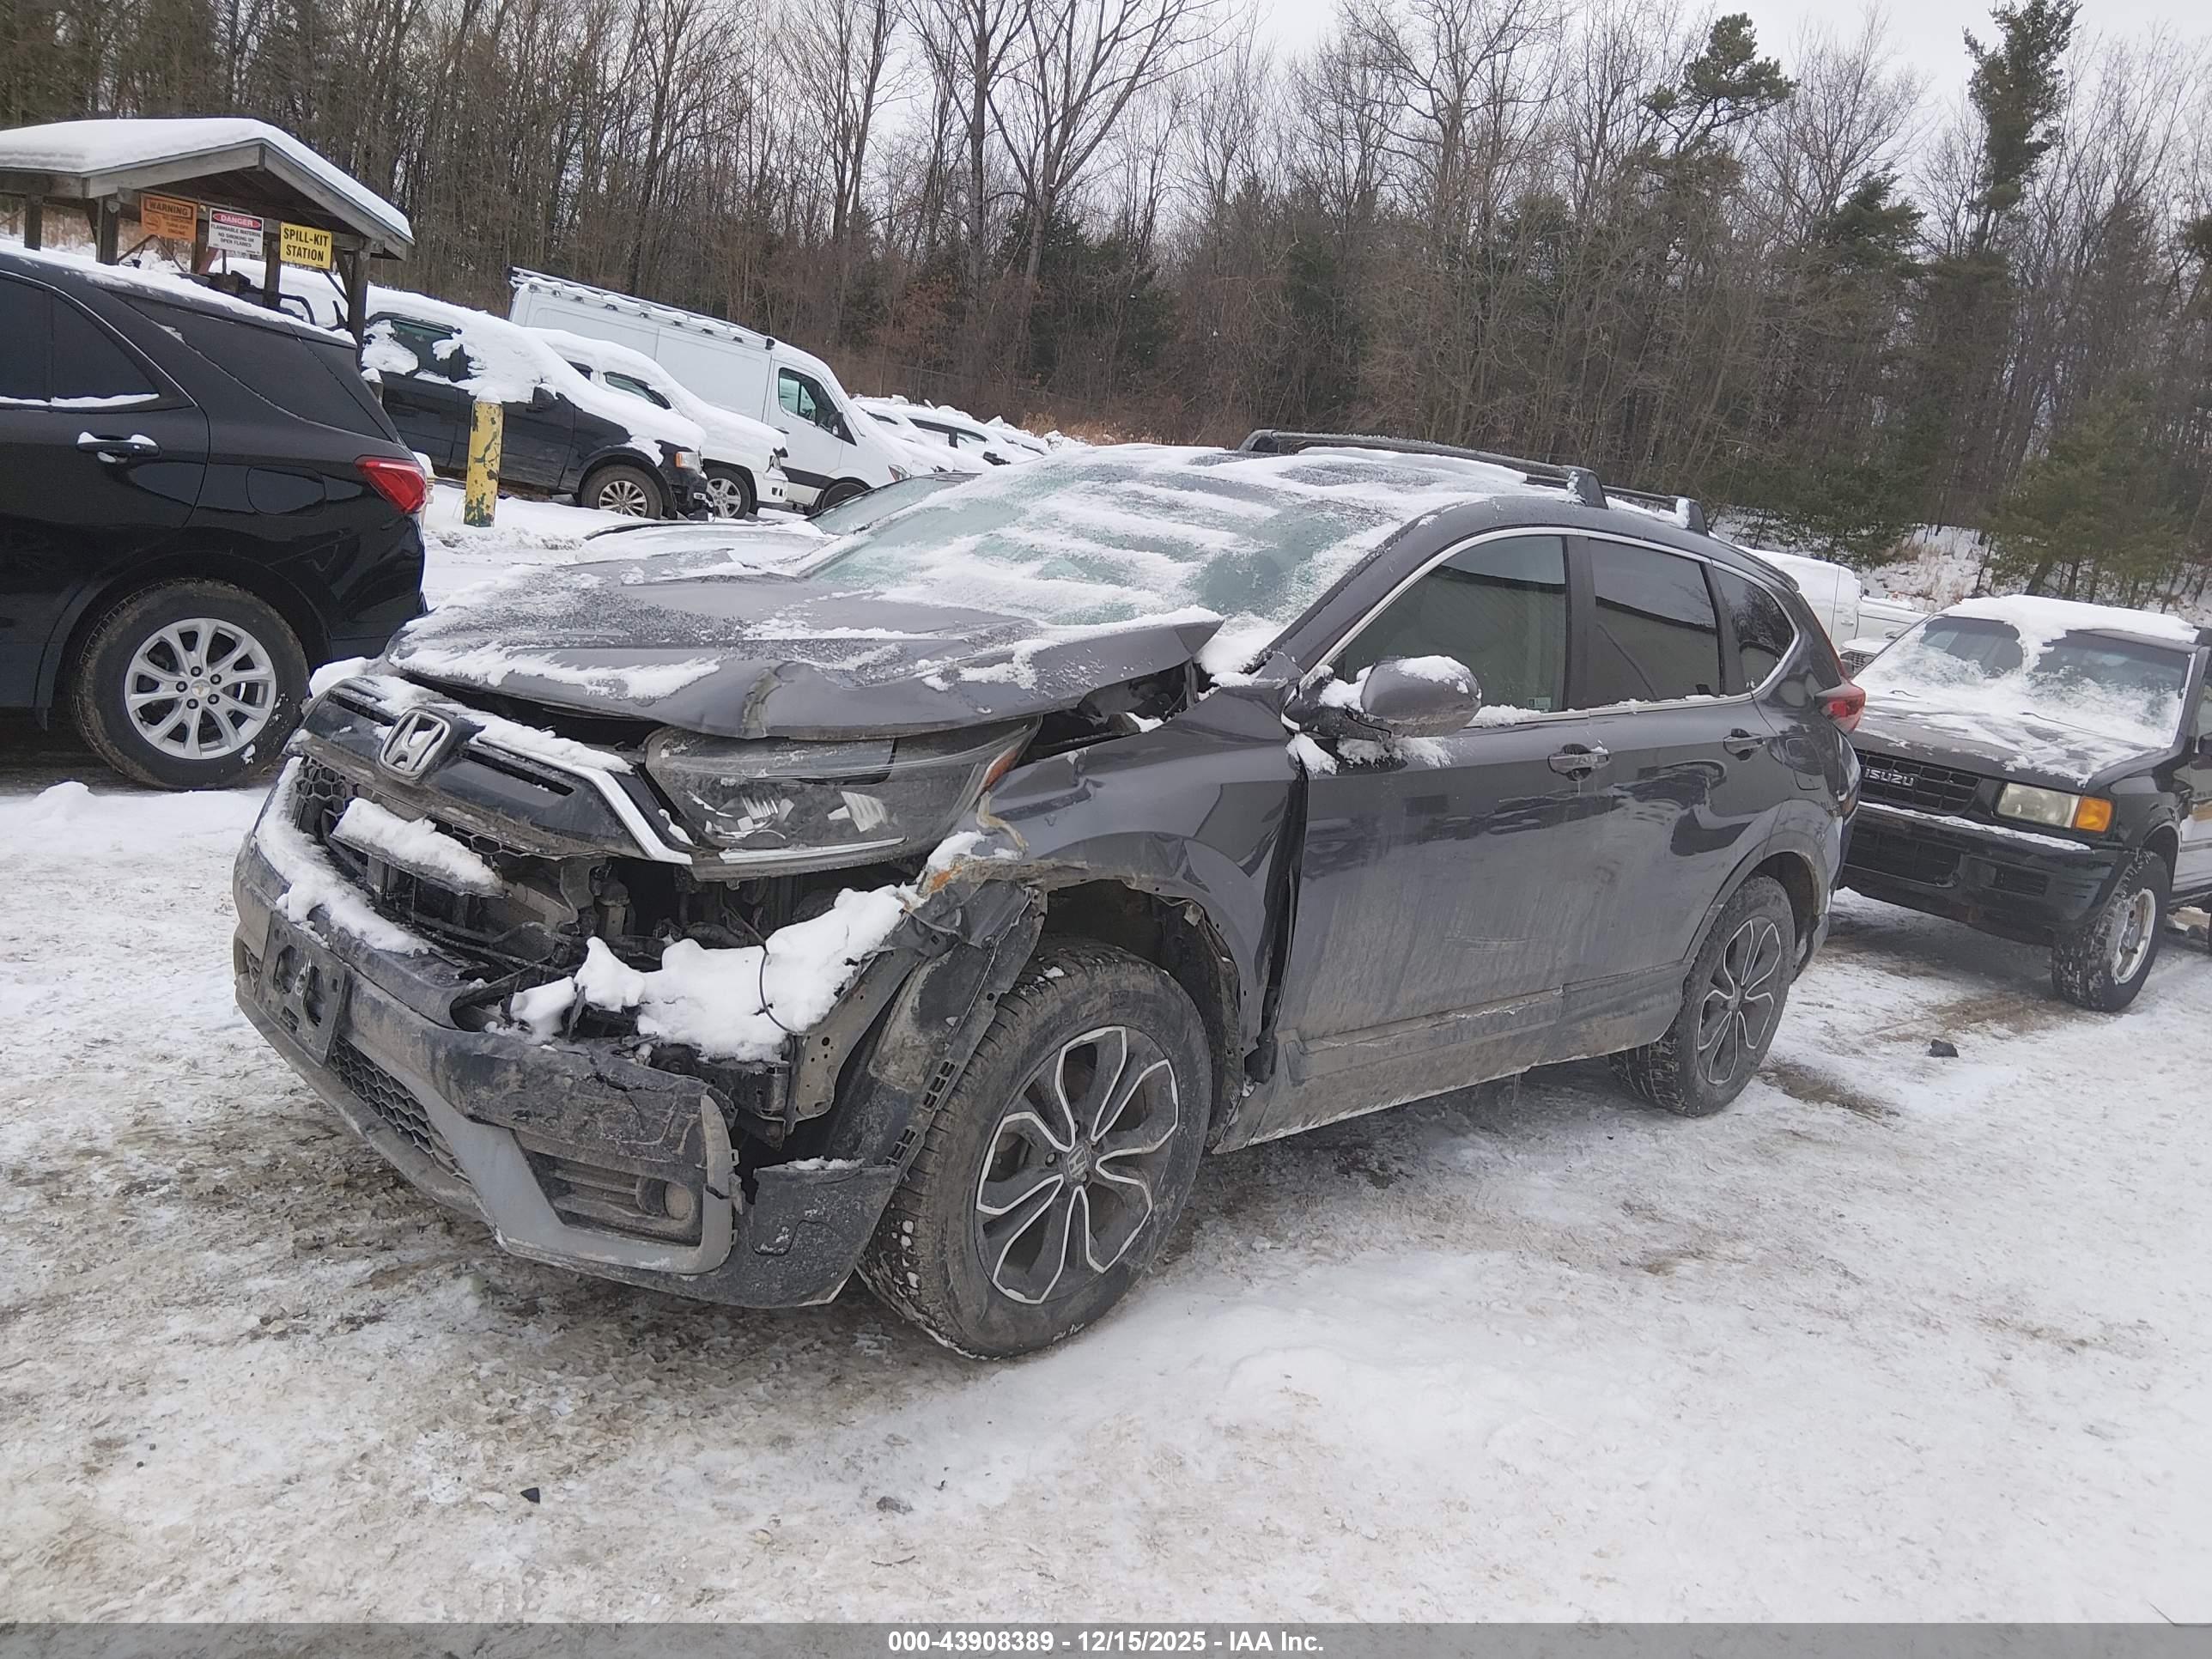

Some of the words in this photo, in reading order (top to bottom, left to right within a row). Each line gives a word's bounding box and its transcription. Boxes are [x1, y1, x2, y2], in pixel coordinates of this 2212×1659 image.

[149, 202, 188, 216] WARNING
[211, 223, 239, 234] FLAMMABLE
[220, 215, 252, 228] DANGER
[283, 228, 329, 247] SPILL-KIT
[286, 244, 324, 262] STATION
[1864, 768, 1914, 787] ISUZU
